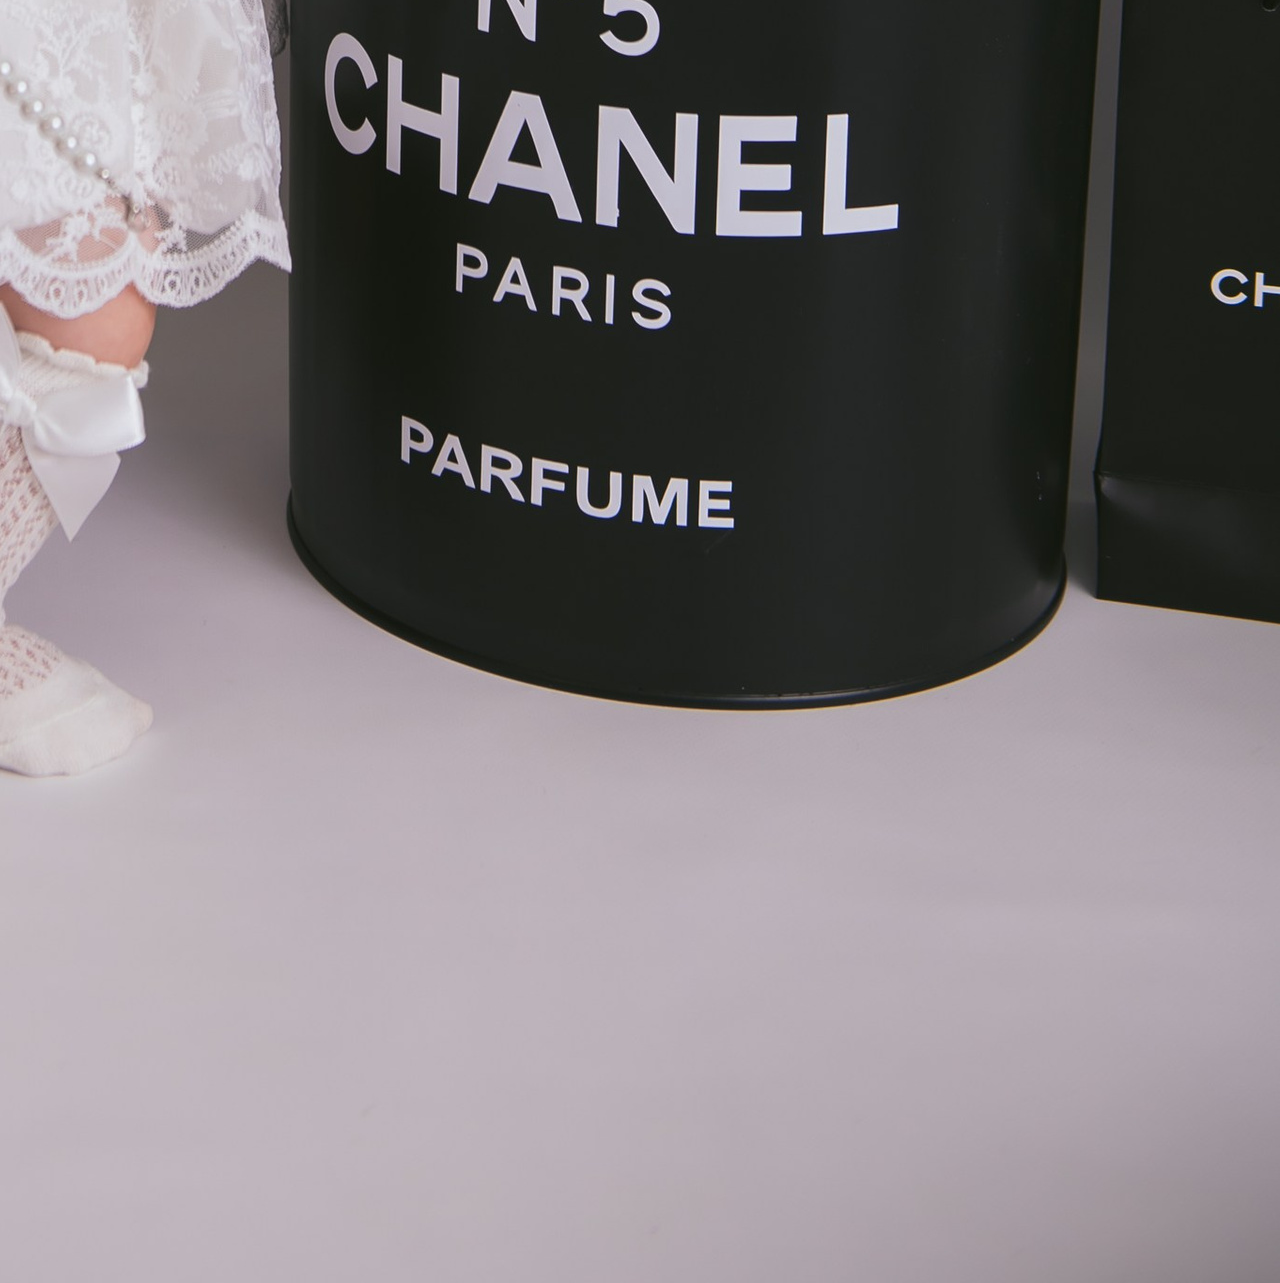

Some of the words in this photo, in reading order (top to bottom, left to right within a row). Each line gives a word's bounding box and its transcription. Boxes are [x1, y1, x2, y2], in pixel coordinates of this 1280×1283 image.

[325, 33, 899, 237] CHANEL
[455, 243, 672, 330] PARIS
[400, 415, 735, 529] PARFUME
